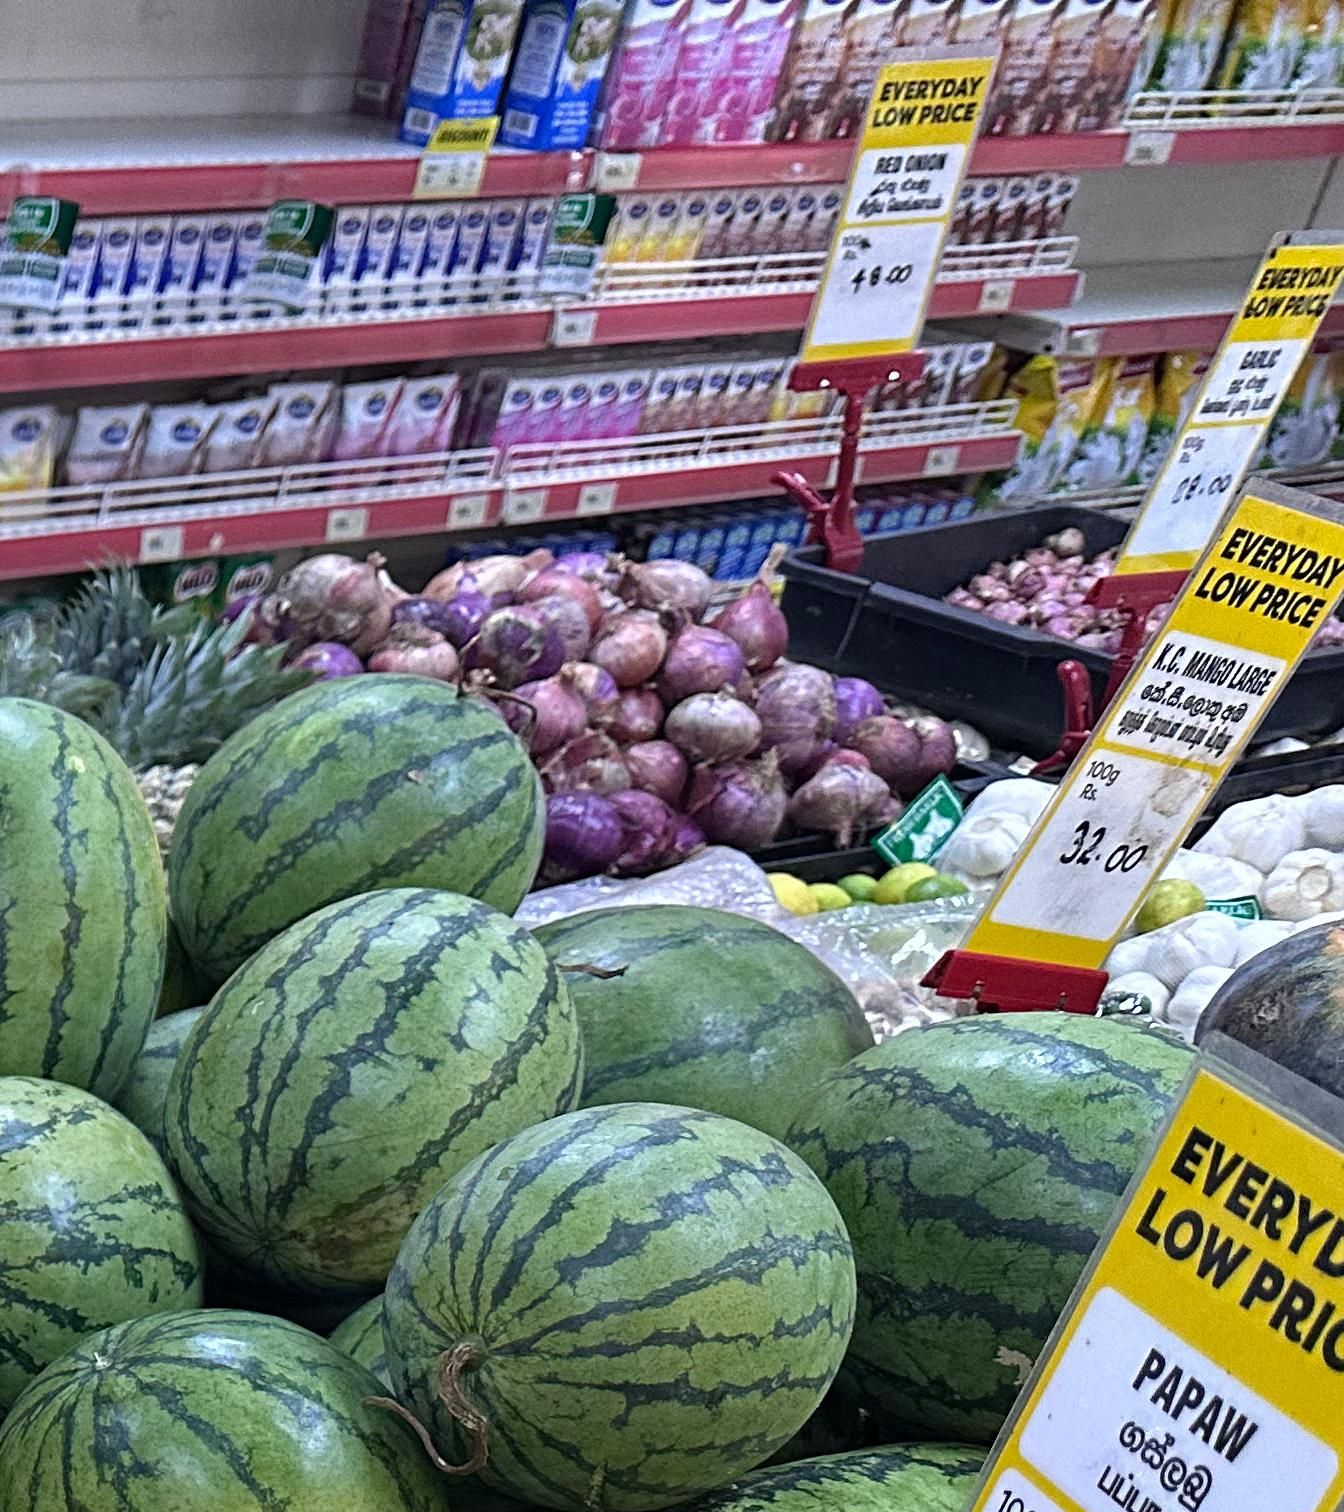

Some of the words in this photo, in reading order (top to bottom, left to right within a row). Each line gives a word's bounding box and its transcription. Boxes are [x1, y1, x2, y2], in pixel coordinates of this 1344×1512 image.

[880, 77, 985, 101] EVERYDAY
[872, 107, 918, 127] LOW
[918, 102, 977, 125] PRICE
[874, 155, 902, 174] RED
[1256, 265, 1344, 290] EVERYDAY
[1242, 296, 1283, 320] LOW
[1281, 293, 1330, 318] PRICE
[1220, 527, 1344, 591] EVERYDAY
[1194, 567, 1255, 613] LOW
[1255, 584, 1327, 629] PRICE
[1152, 642, 1186, 675] K.C.
[1181, 650, 1237, 687] MANGO
[1226, 662, 1278, 697] LARGE
[1085, 759, 1121, 786] 100g
[1079, 784, 1098, 802] Rs.
[1060, 820, 1151, 875] 32.00
[1134, 1188, 1252, 1290] LOW
[1131, 1347, 1259, 1463] PAPAW
